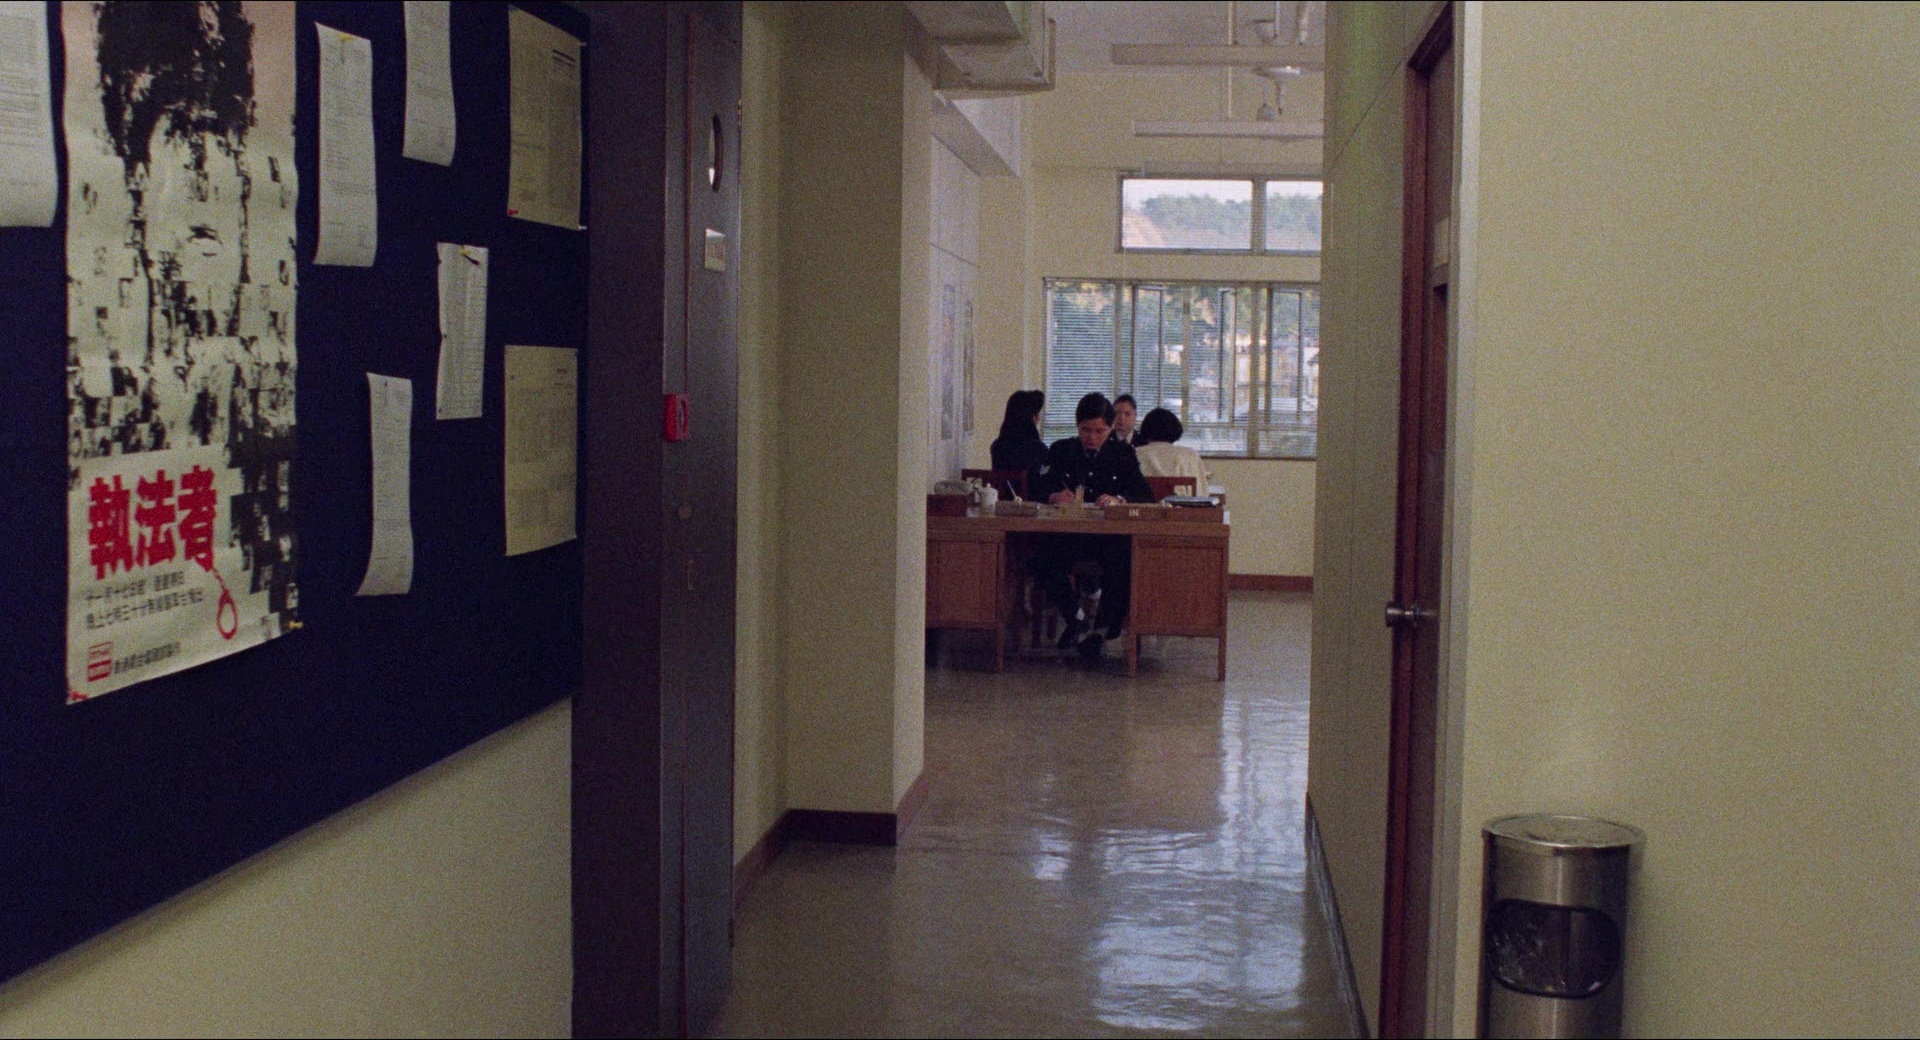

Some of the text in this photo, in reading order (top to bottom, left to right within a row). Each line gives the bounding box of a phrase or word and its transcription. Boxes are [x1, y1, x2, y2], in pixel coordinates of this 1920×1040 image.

[88, 465, 217, 580] 執法者
[1129, 508, 1139, 517] IN
